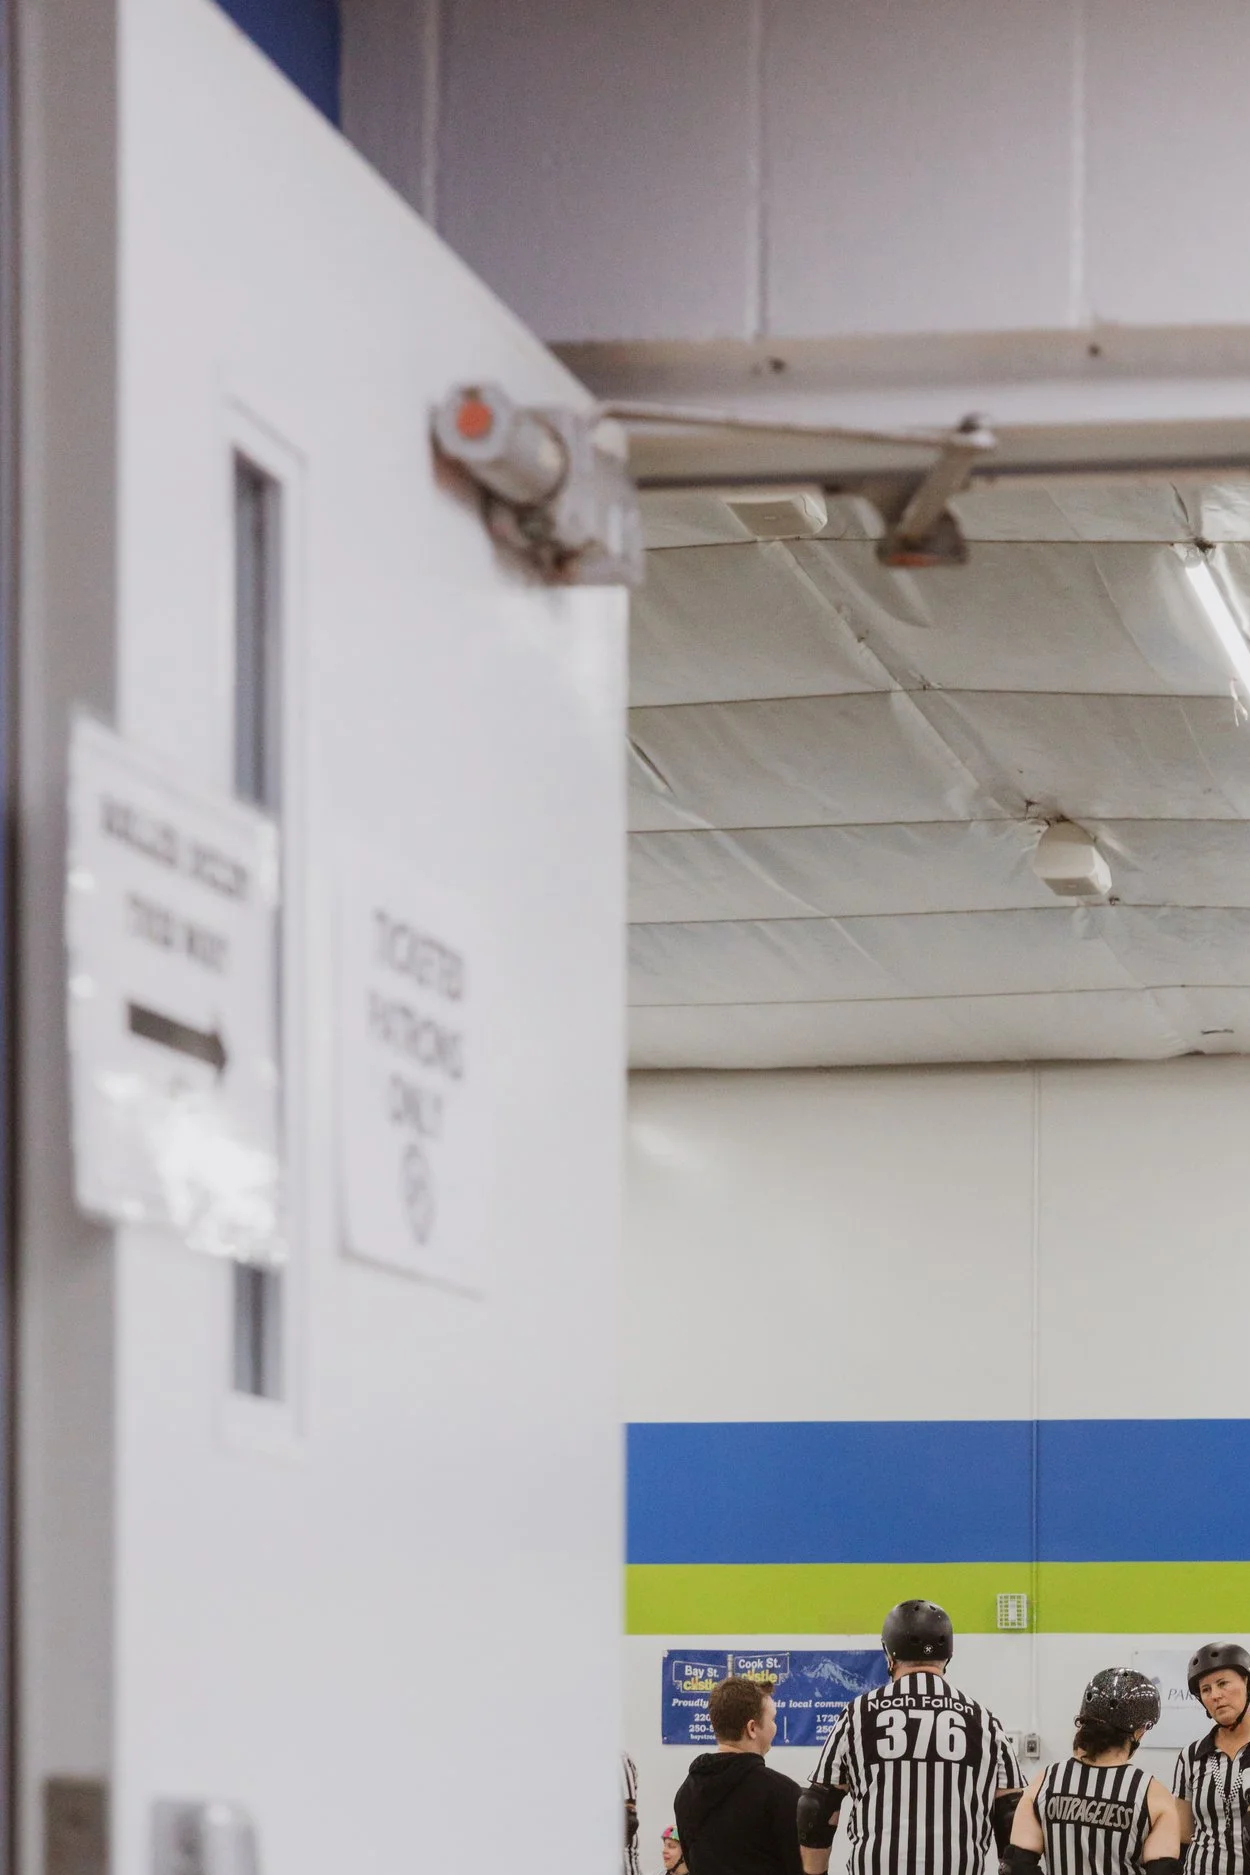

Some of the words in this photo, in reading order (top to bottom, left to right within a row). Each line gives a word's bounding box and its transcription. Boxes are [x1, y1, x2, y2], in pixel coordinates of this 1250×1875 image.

[684, 1664, 705, 1679] Bay
[706, 1667, 719, 1678] St.
[738, 1659, 763, 1669] Cook
[766, 1657, 781, 1668] St.
[671, 1698, 709, 1709] Proudly
[789, 1700, 812, 1708] local
[867, 1695, 917, 1712] Noah
[922, 1696, 974, 1716] Fallon
[876, 1709, 967, 1761] 376
[1047, 1795, 1134, 1830] OUTRAGEJESS
